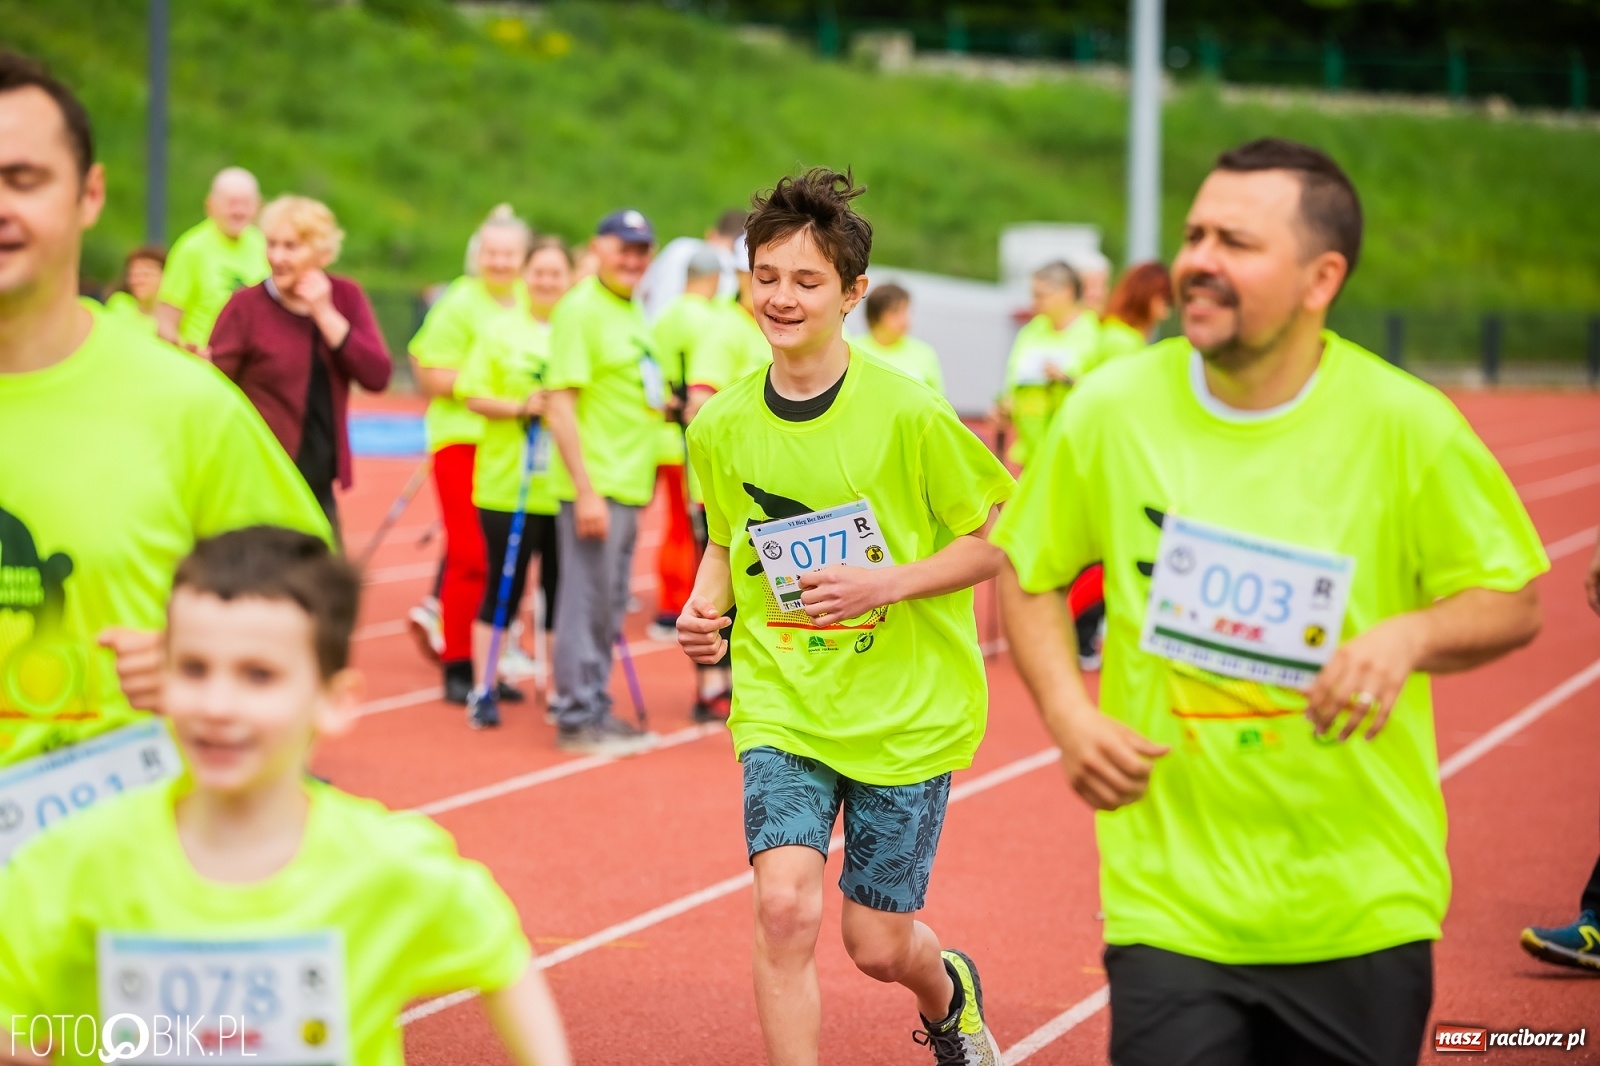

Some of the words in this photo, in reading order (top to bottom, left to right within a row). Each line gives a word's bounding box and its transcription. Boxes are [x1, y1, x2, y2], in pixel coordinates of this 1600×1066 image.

[790, 529, 847, 569] 077
[853, 517, 871, 532] R
[1200, 563, 1295, 625] 003
[158, 963, 283, 1024] 078
